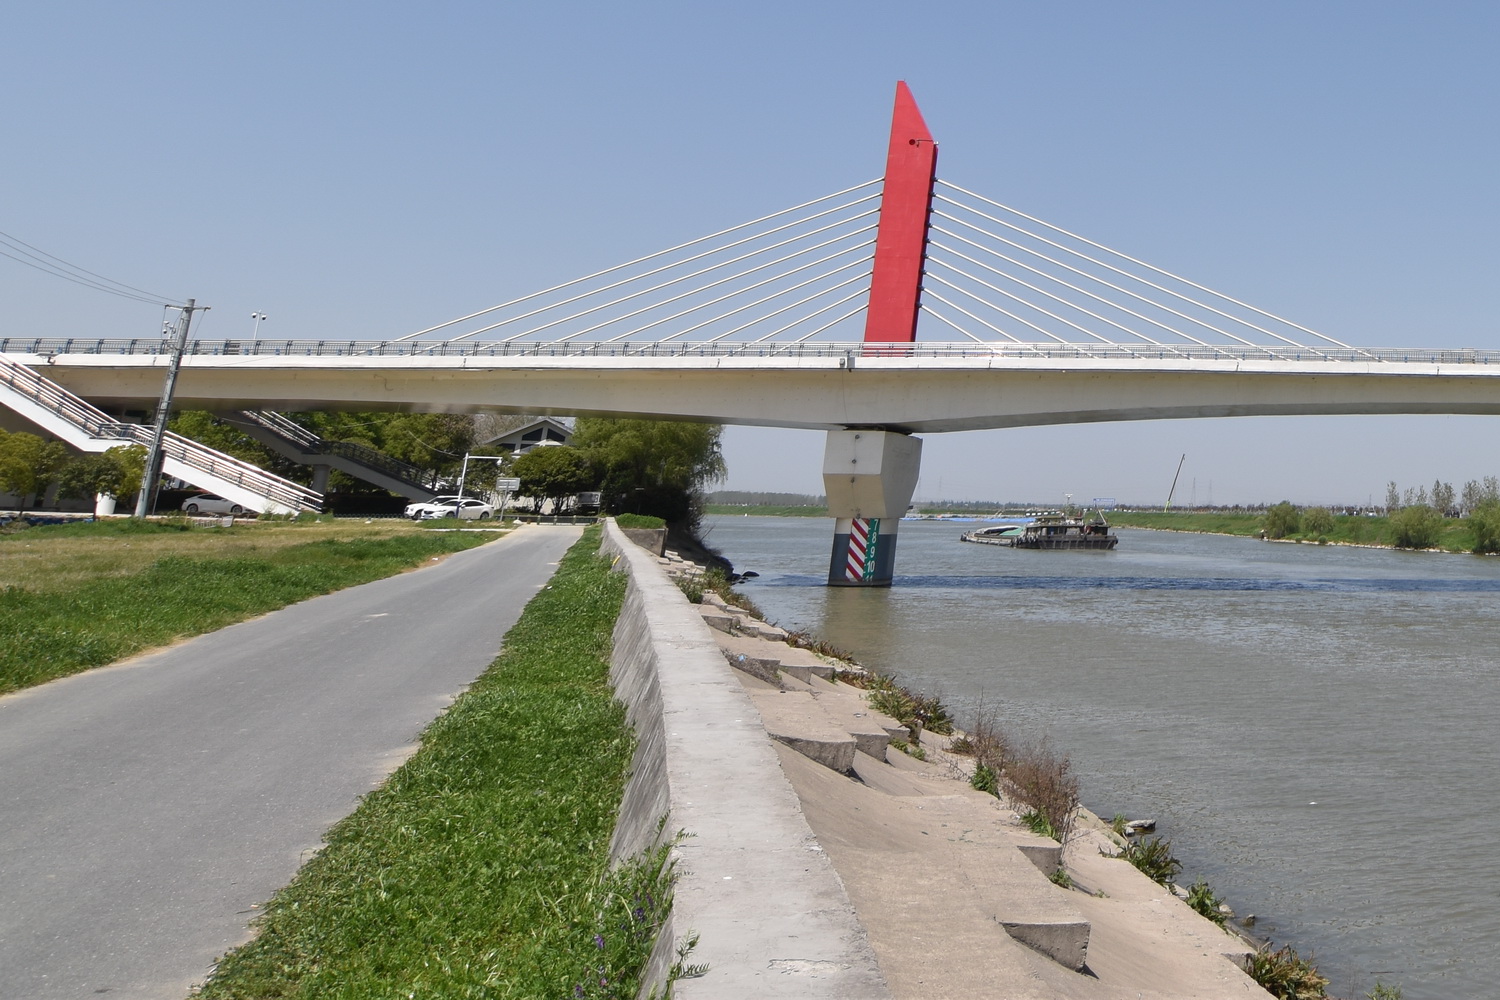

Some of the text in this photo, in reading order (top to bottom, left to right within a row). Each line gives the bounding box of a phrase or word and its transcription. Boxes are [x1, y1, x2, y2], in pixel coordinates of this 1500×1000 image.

[874, 518, 878, 531] 7
[872, 532, 877, 544] 8
[870, 546, 876, 558] 9
[867, 560, 875, 572] 10
